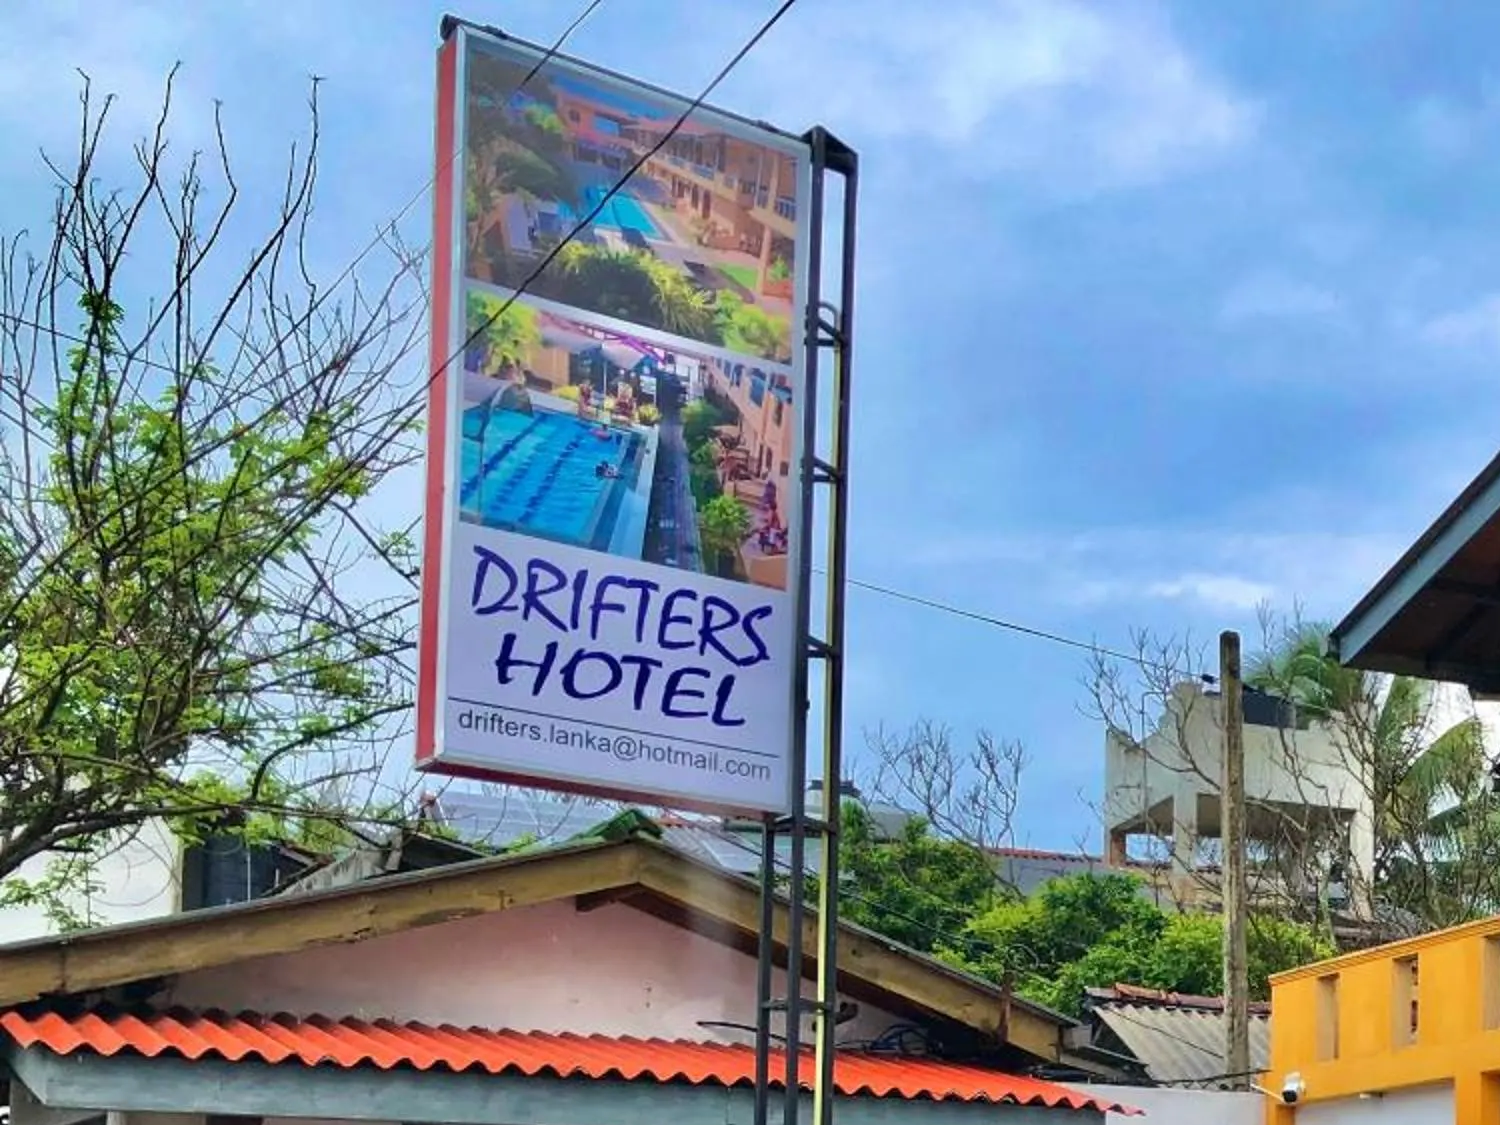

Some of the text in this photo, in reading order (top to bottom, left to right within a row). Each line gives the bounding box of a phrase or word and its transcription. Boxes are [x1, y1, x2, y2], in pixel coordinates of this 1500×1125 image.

[472, 545, 773, 666] DRIFTERS
[495, 633, 746, 726] HOTEL
[458, 708, 771, 781] drifters.lanka@hotmail.com
